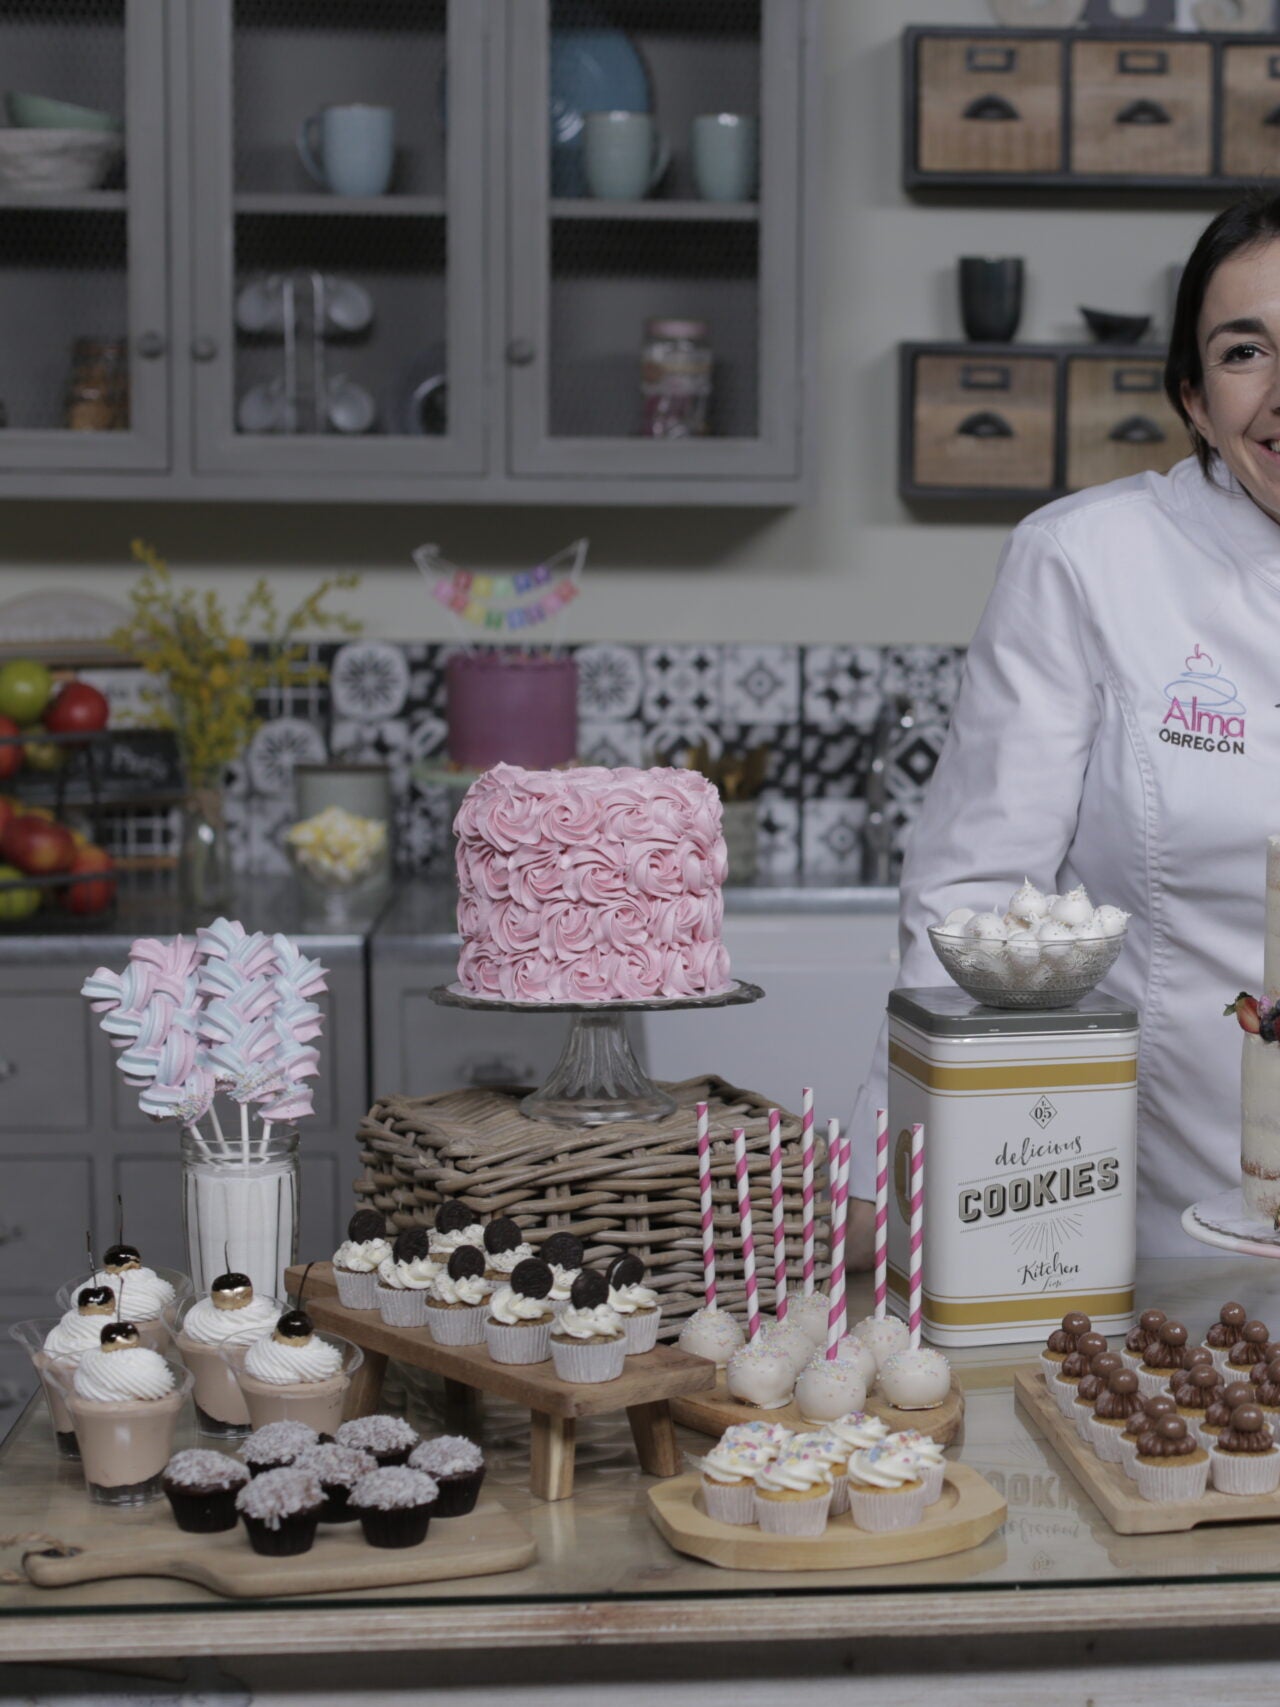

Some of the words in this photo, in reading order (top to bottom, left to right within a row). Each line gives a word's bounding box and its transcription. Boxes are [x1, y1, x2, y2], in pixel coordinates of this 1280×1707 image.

[1162, 696, 1246, 738] Alma
[1158, 728, 1245, 755] OBREGÓN
[1034, 1106, 1052, 1120] 05
[995, 1136, 1082, 1166] delicious
[958, 1157, 1120, 1223] COOKIES
[1017, 1252, 1081, 1286] Kitchen
